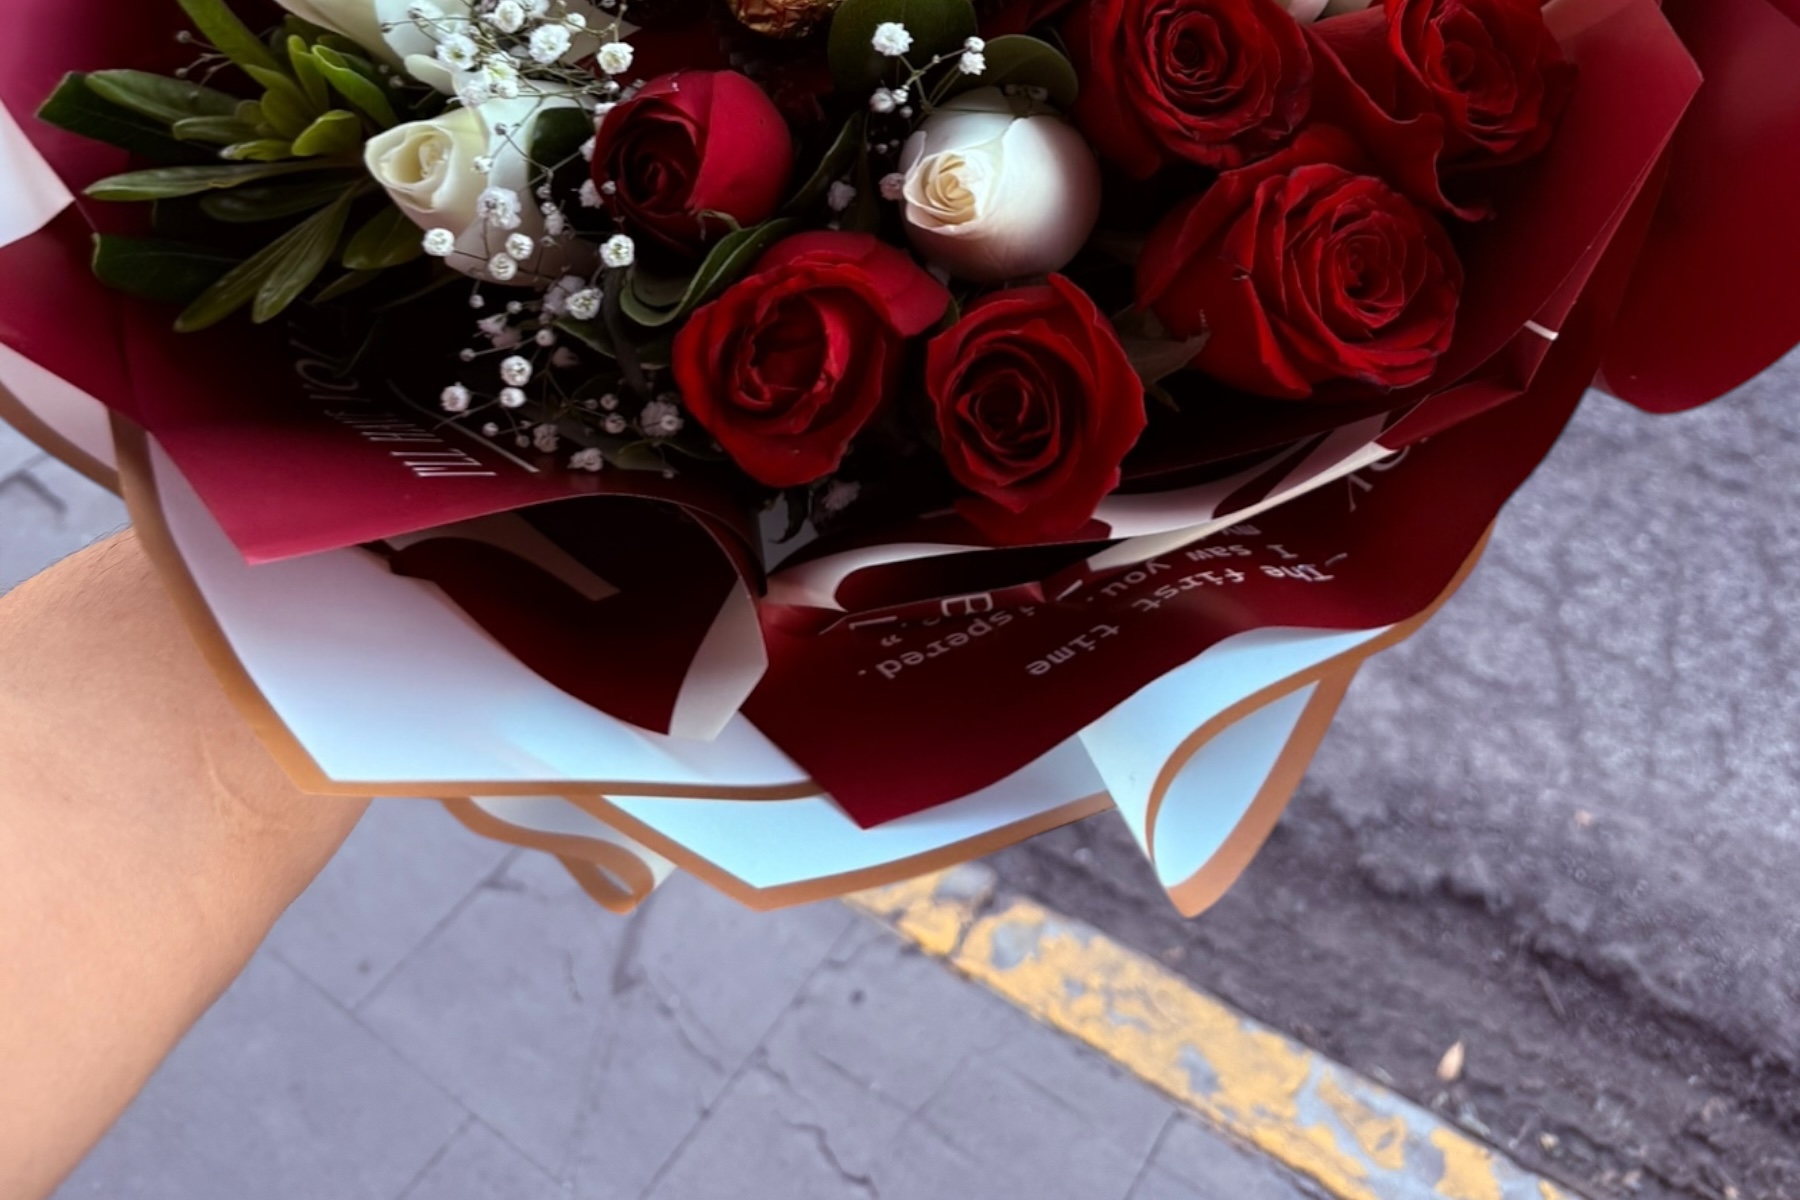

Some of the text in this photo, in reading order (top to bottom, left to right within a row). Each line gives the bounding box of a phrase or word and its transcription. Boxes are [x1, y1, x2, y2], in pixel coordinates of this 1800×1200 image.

[1184, 543, 1255, 563] saw
[1085, 558, 1172, 604] you.
[1131, 568, 1246, 613] first
[1025, 623, 1121, 677] time
